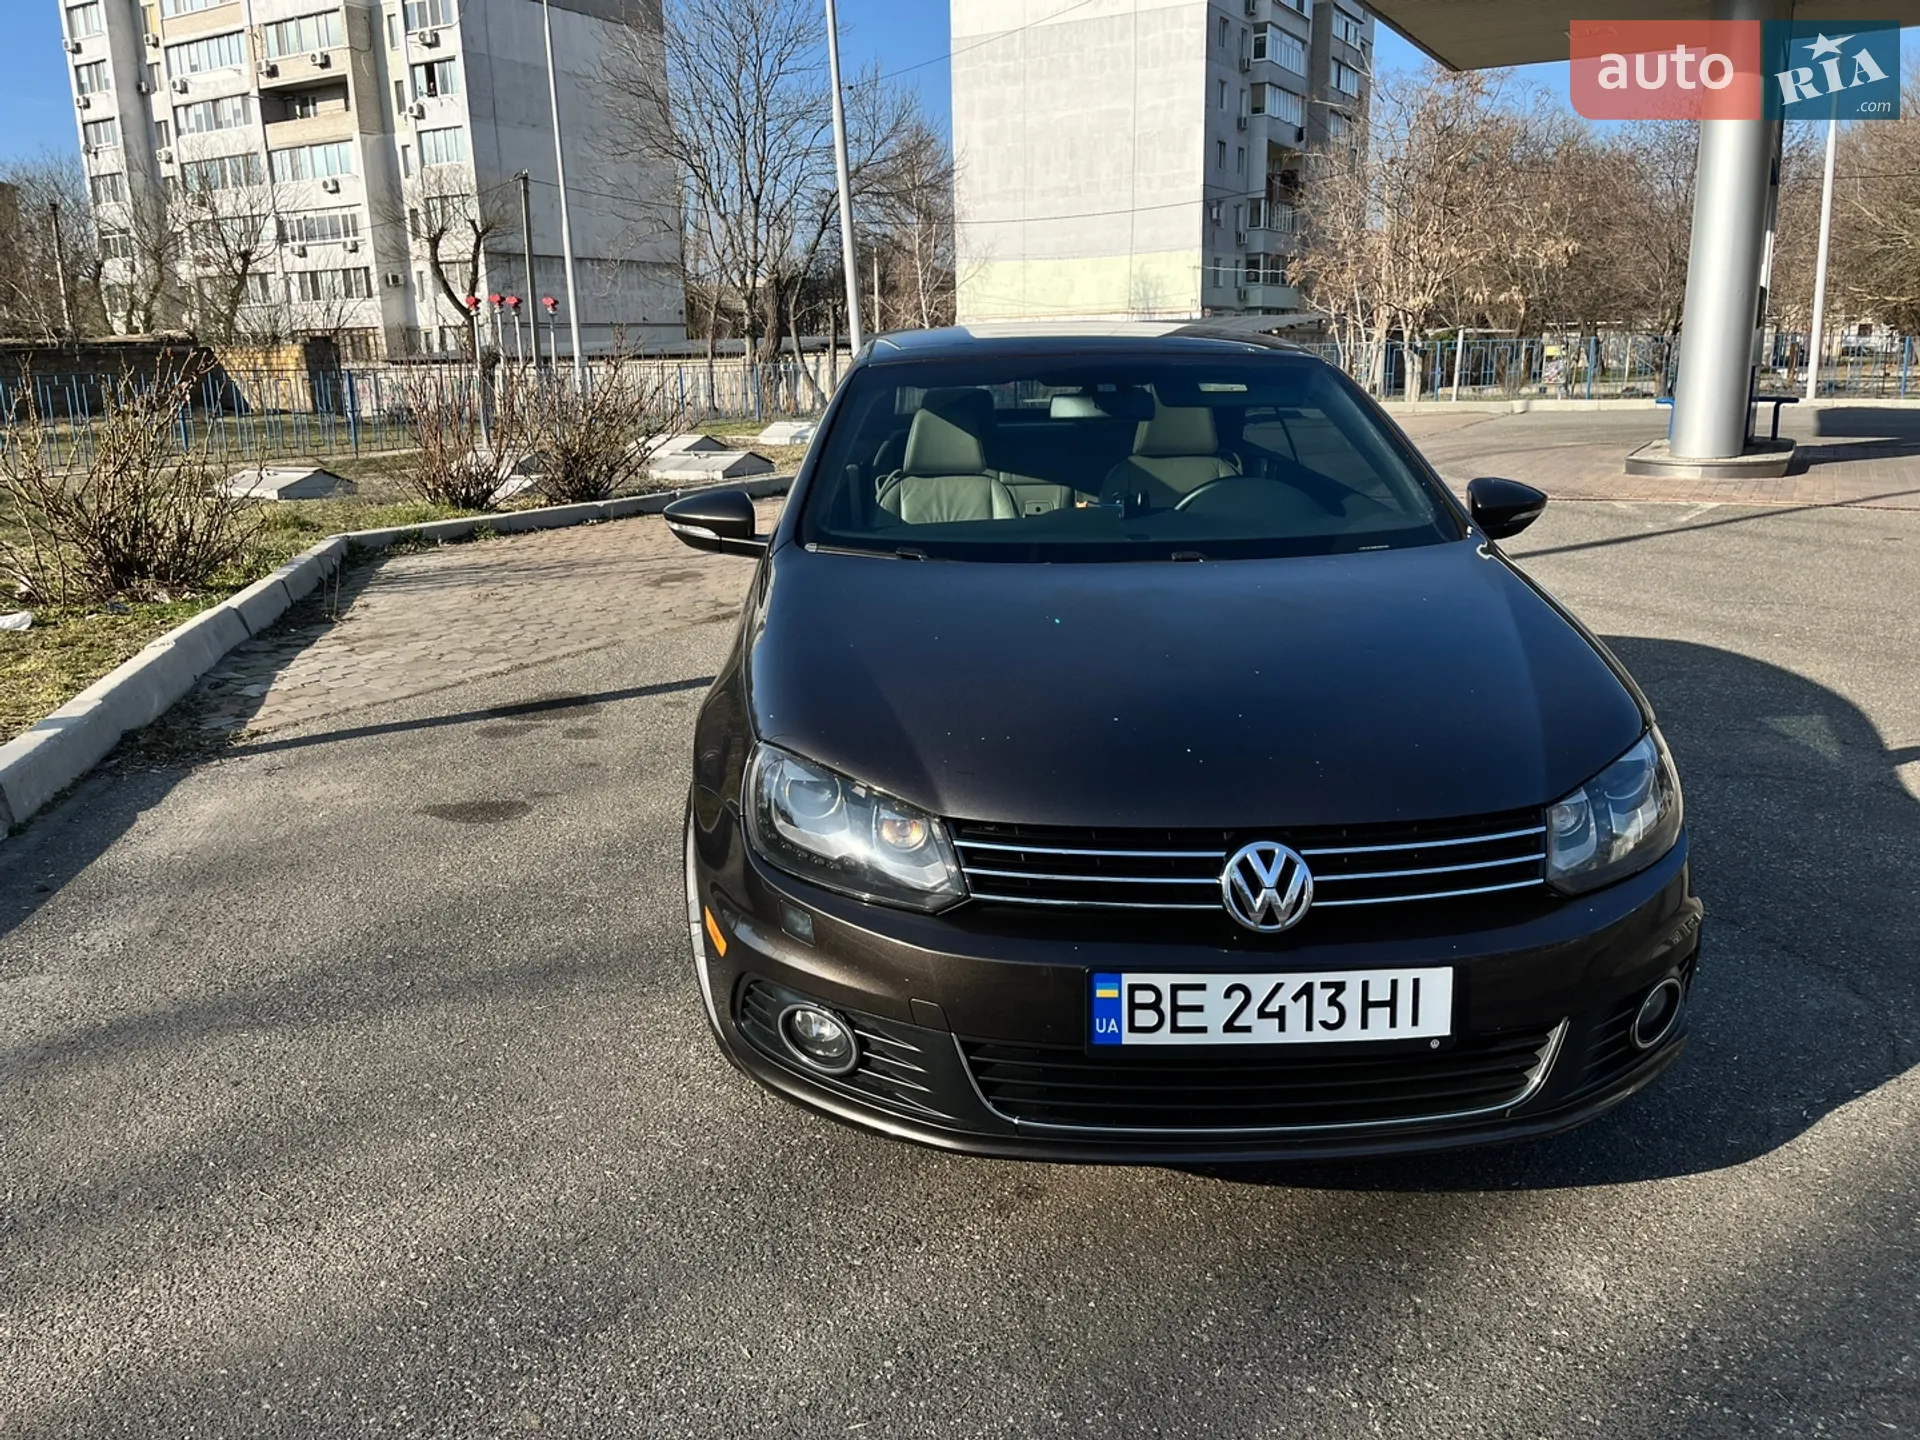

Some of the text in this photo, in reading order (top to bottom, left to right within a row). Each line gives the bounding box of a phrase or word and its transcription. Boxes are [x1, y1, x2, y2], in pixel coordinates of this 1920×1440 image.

[1127, 977, 1420, 1034] BE 2413 HI
[1096, 1018, 1119, 1034] UA
